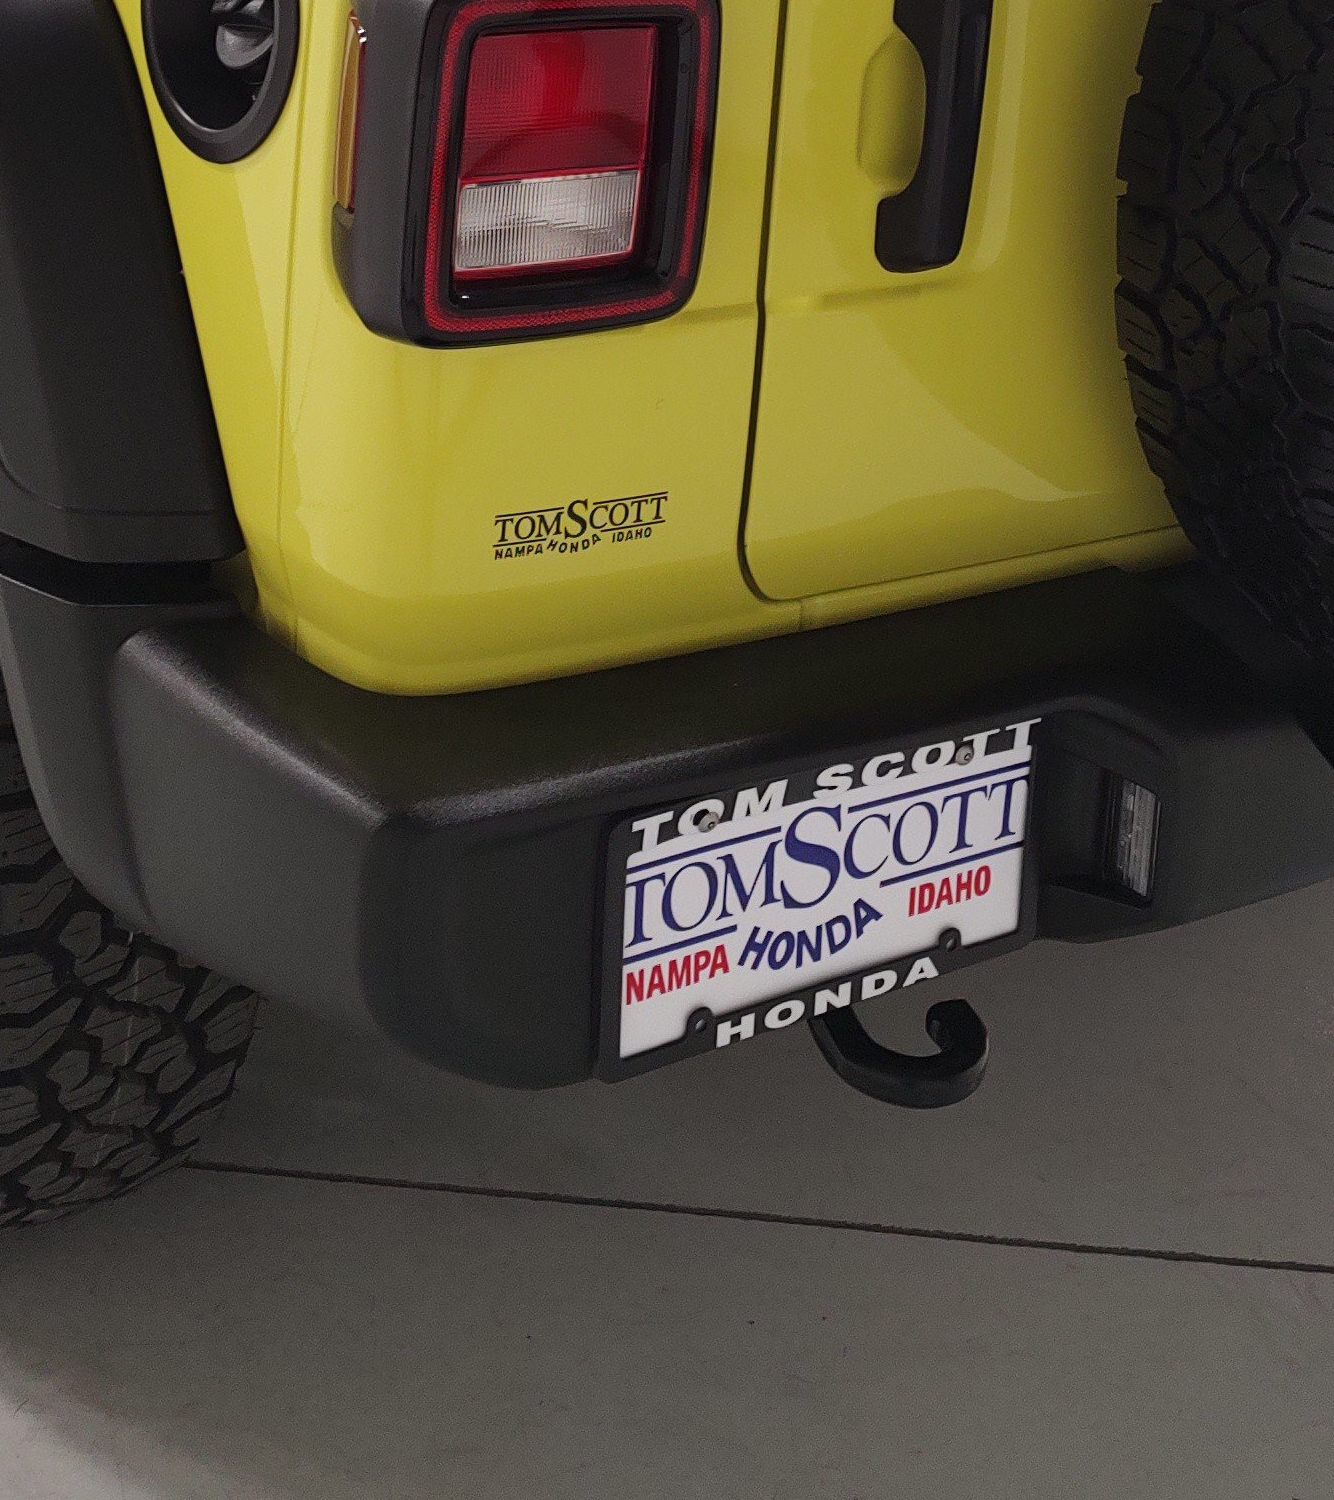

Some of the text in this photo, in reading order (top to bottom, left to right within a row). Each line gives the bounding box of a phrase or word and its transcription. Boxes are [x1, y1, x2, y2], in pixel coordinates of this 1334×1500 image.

[494, 526, 653, 560] NAMPA HONDA IDAHO
[631, 718, 1042, 854] TOM SCOTT
[625, 865, 992, 1006] NAMPA HONDA IDAHO
[716, 956, 939, 1048] HONDA
